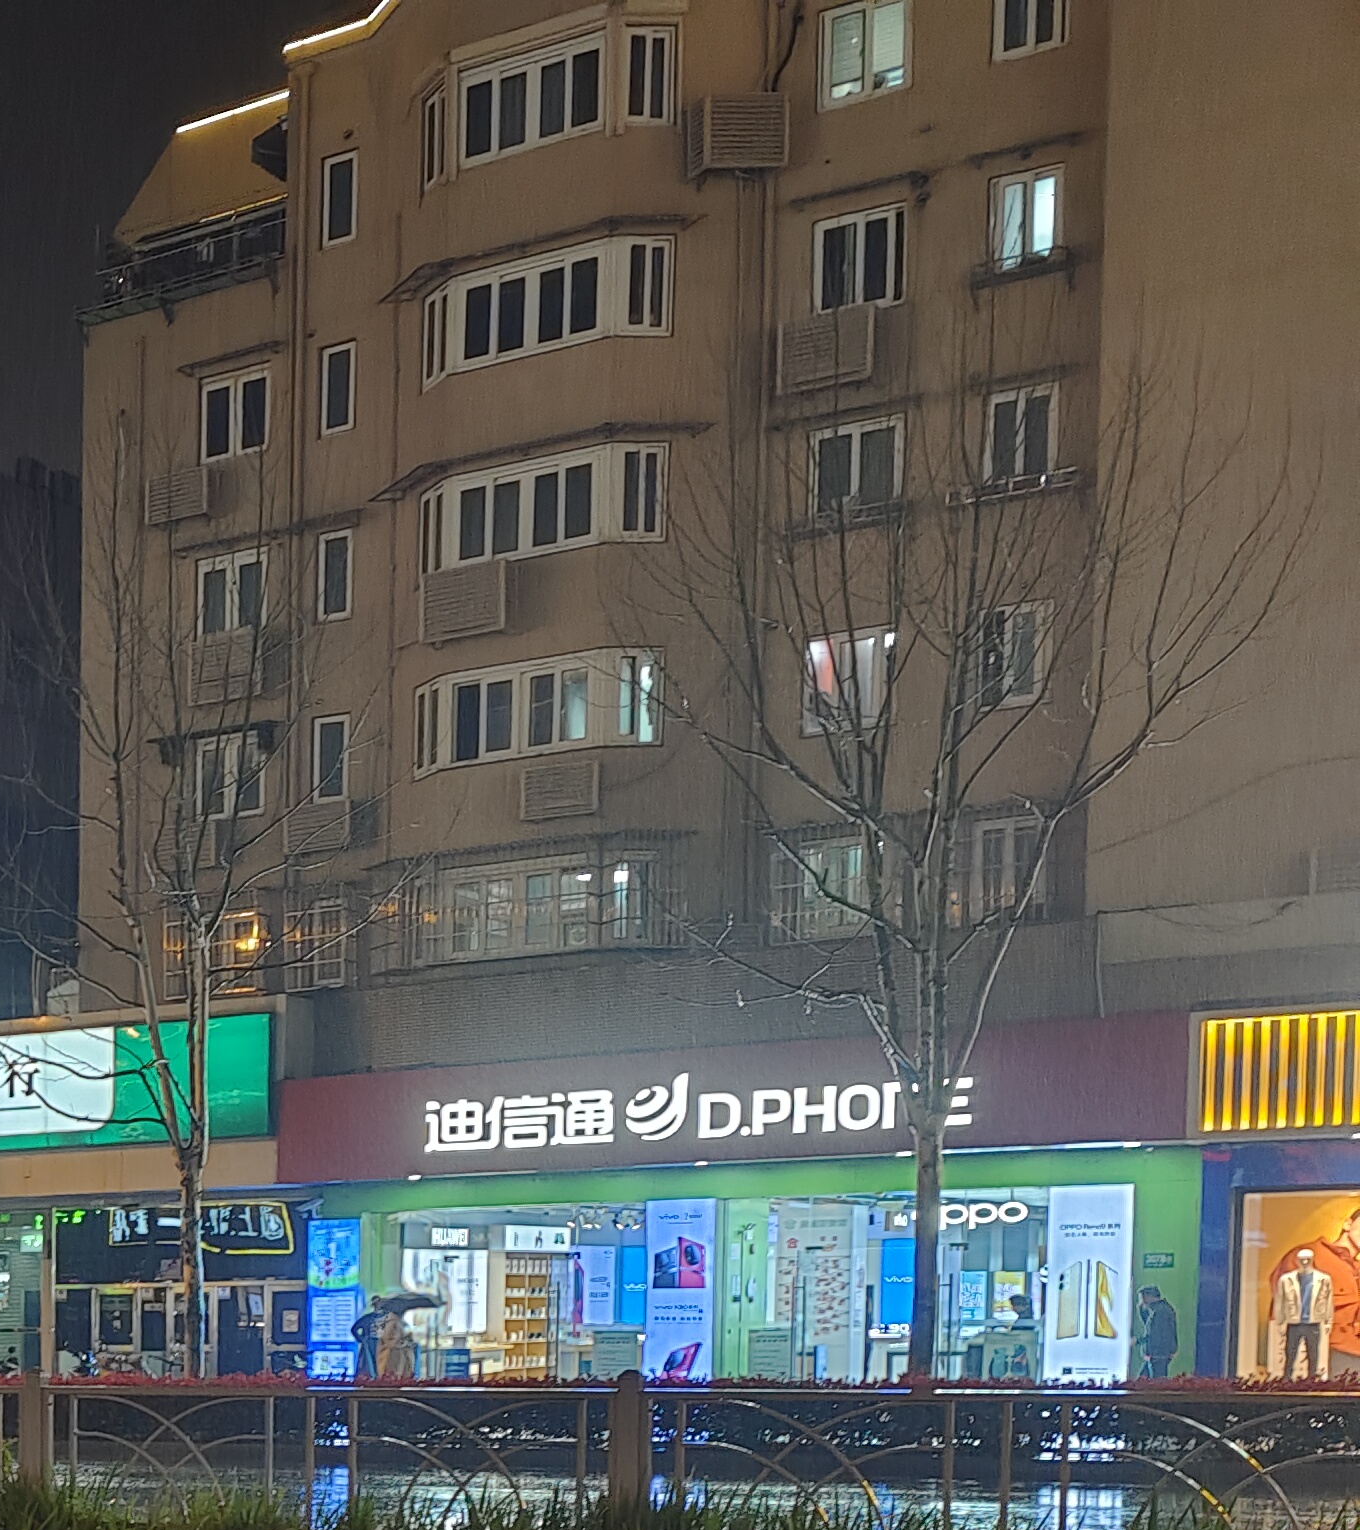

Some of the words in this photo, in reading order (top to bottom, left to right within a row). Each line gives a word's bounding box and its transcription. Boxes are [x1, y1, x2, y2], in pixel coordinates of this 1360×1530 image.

[423, 1089, 614, 1154] 迪信通
[911, 1201, 1029, 1231] ppo
